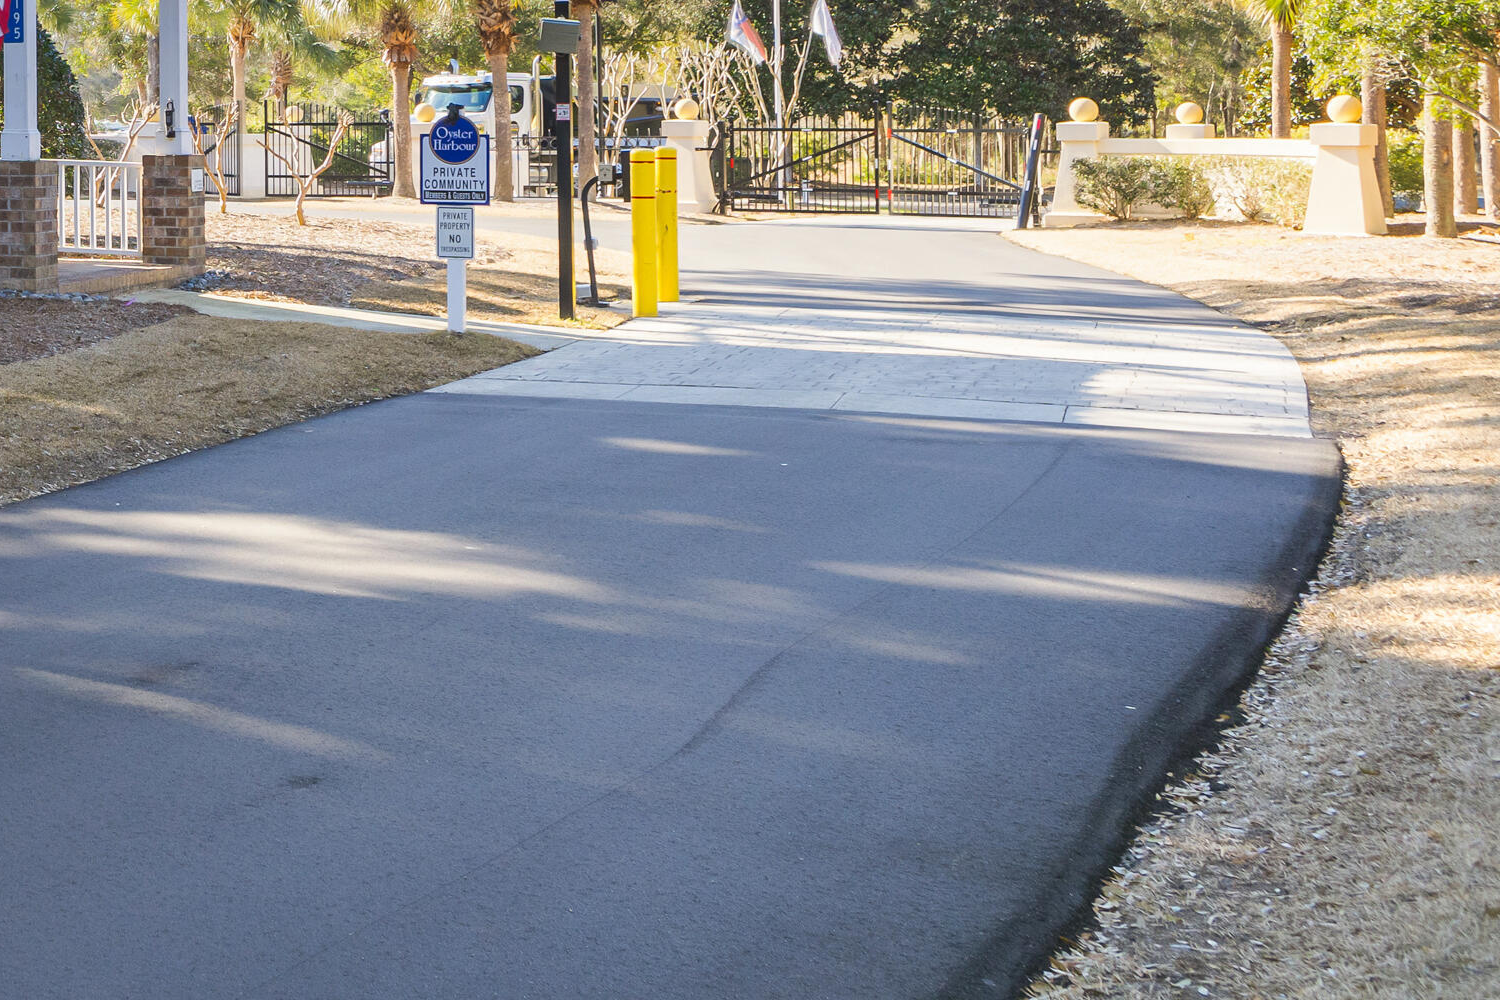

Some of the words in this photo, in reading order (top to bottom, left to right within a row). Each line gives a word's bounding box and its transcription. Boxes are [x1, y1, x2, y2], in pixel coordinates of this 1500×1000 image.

[436, 126, 473, 142] Oyster
[433, 139, 476, 151] Harbour
[433, 167, 476, 178] PRIVATE
[424, 179, 485, 190] COMMUNITY
[442, 212, 468, 220] PRIVATE
[440, 222, 470, 230] PROPERTY
[449, 234, 461, 243] NO
